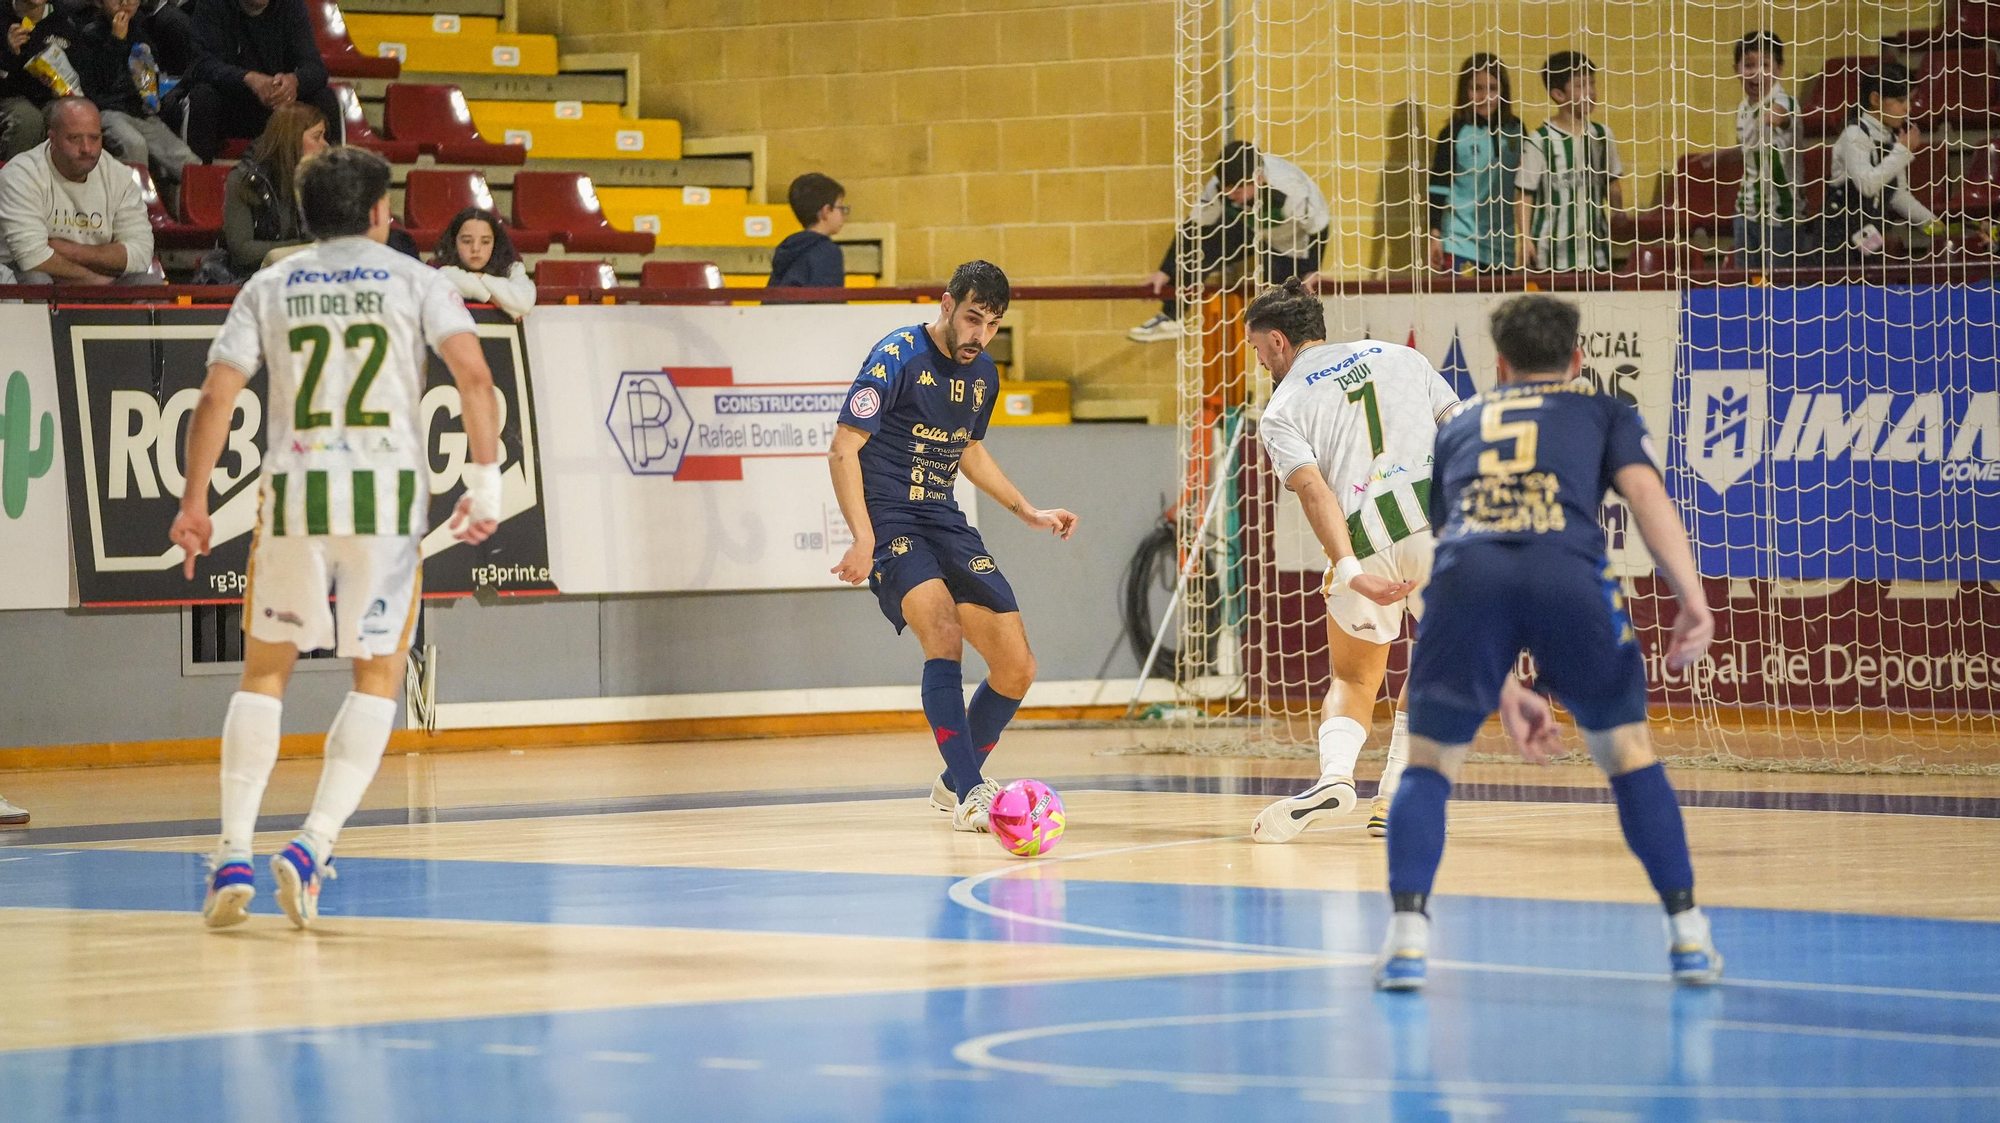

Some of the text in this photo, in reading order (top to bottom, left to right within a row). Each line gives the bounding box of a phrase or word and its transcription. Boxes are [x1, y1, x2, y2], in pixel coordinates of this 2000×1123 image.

[286, 266, 390, 287] Revalco
[286, 291, 385, 317] TITI DEL REY
[288, 322, 390, 431] 22
[1305, 347, 1383, 387] Revalco
[1333, 362, 1372, 391] ZEQUI
[949, 378, 966, 403] 19
[698, 422, 747, 448] Rafael
[751, 420, 803, 447] Bonilla
[808, 428, 818, 446] e
[911, 423, 949, 443] Celta
[1478, 395, 1544, 477] 5
[926, 491, 947, 501] XUNTA
[972, 558, 994, 572] ABRIL
[1762, 642, 1810, 685] de
[1825, 644, 2000, 698] Deportes
